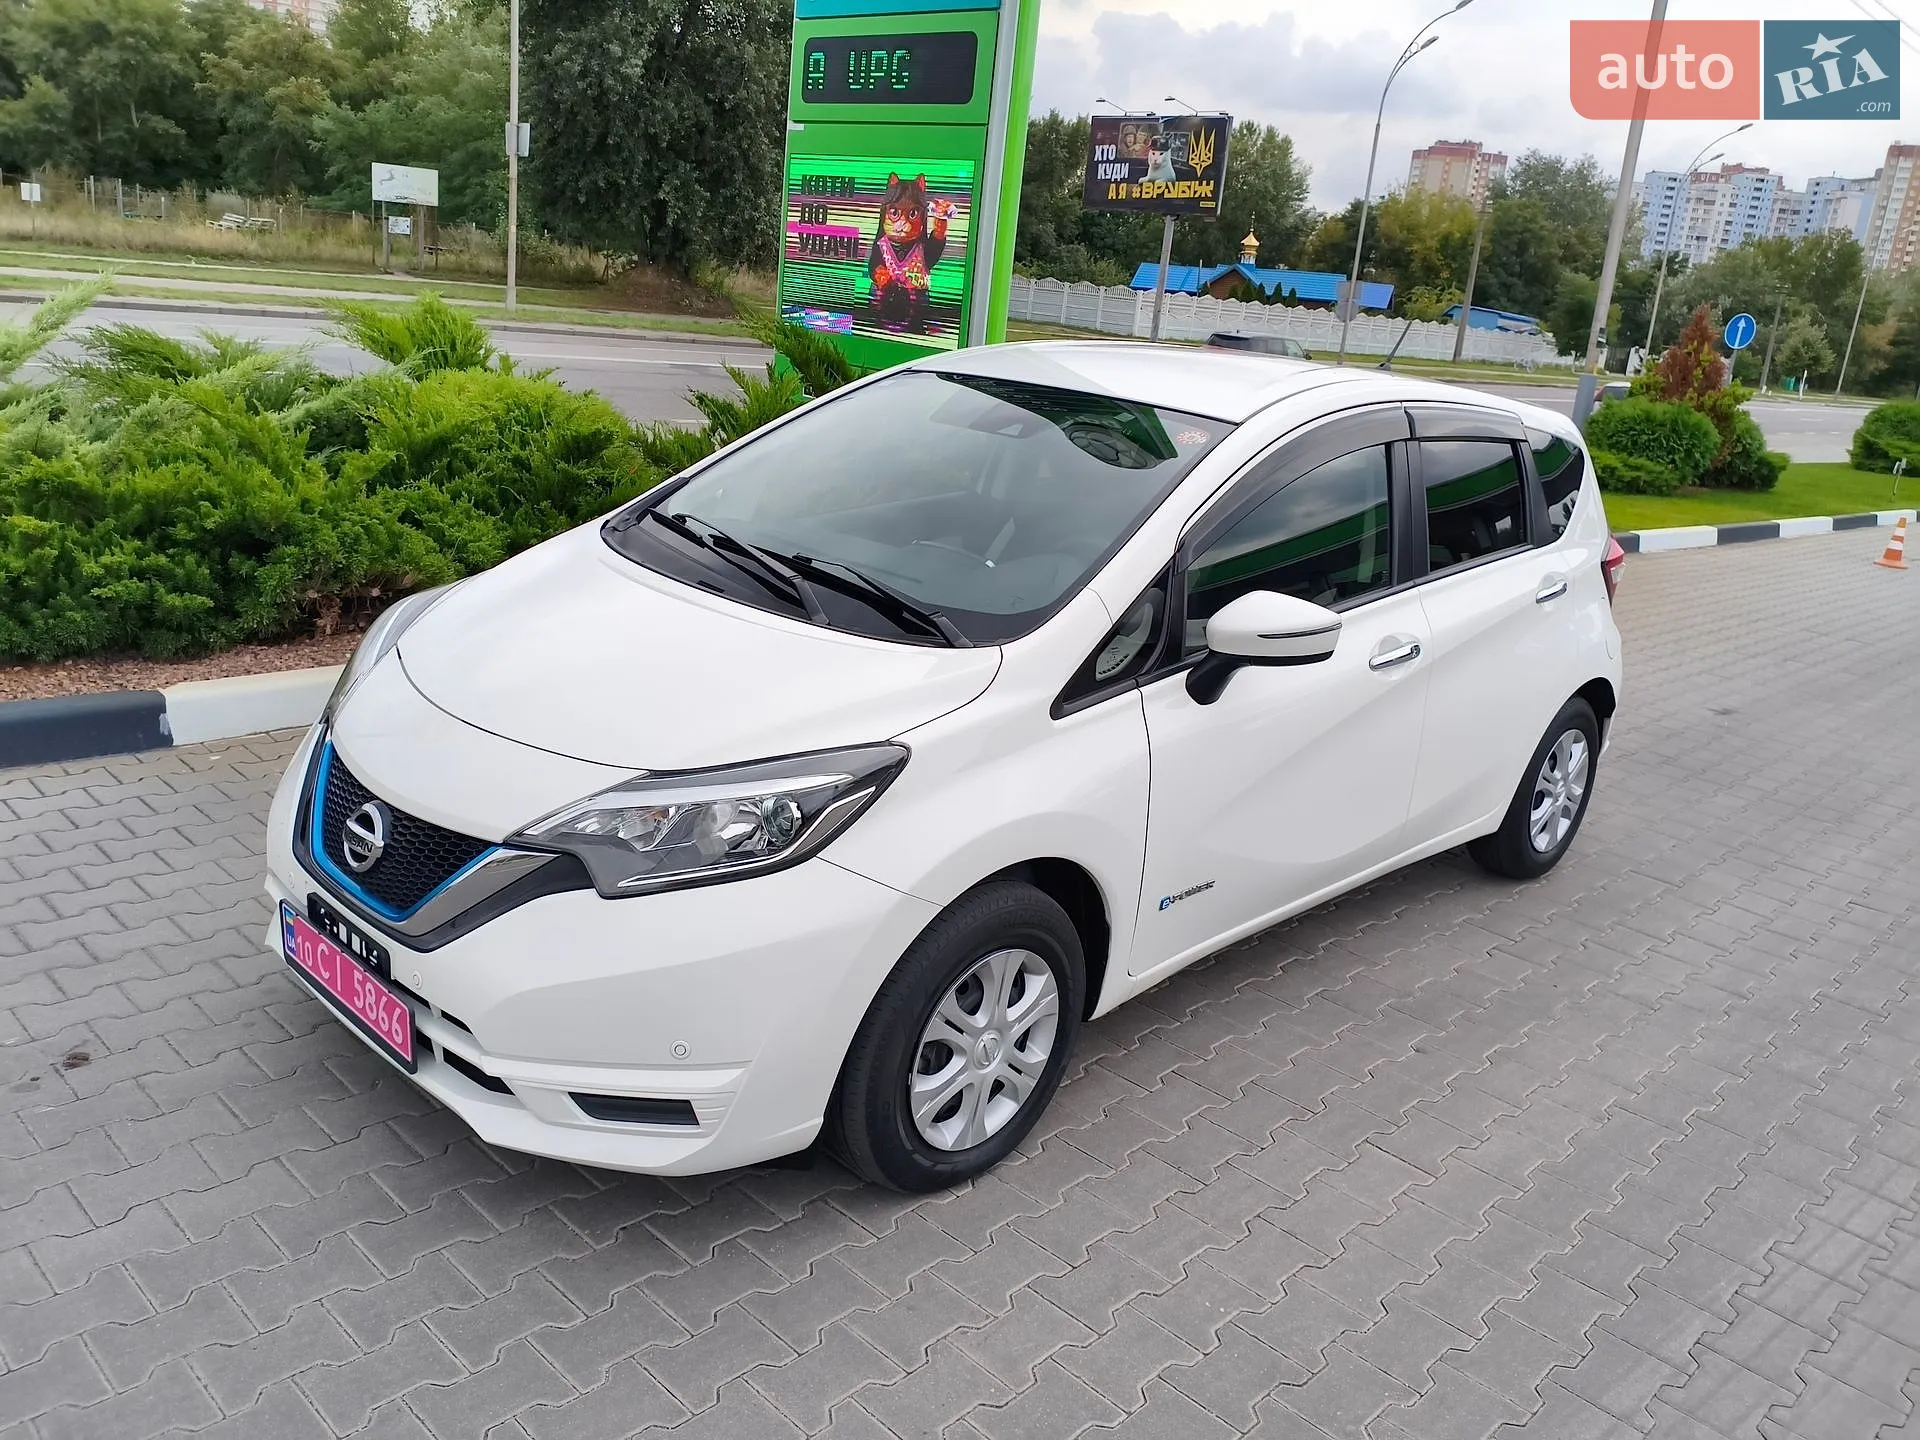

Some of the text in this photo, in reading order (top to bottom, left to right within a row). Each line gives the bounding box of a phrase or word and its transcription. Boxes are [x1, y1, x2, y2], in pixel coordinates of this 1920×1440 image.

[849, 50, 911, 89] UPG
[1094, 145, 1117, 161] ХТО
[1097, 163, 1129, 182] КУДИ
[1108, 184, 1117, 200] А
[1118, 183, 1127, 200] Я
[287, 933, 296, 951] UA
[353, 969, 403, 1046] 5866
